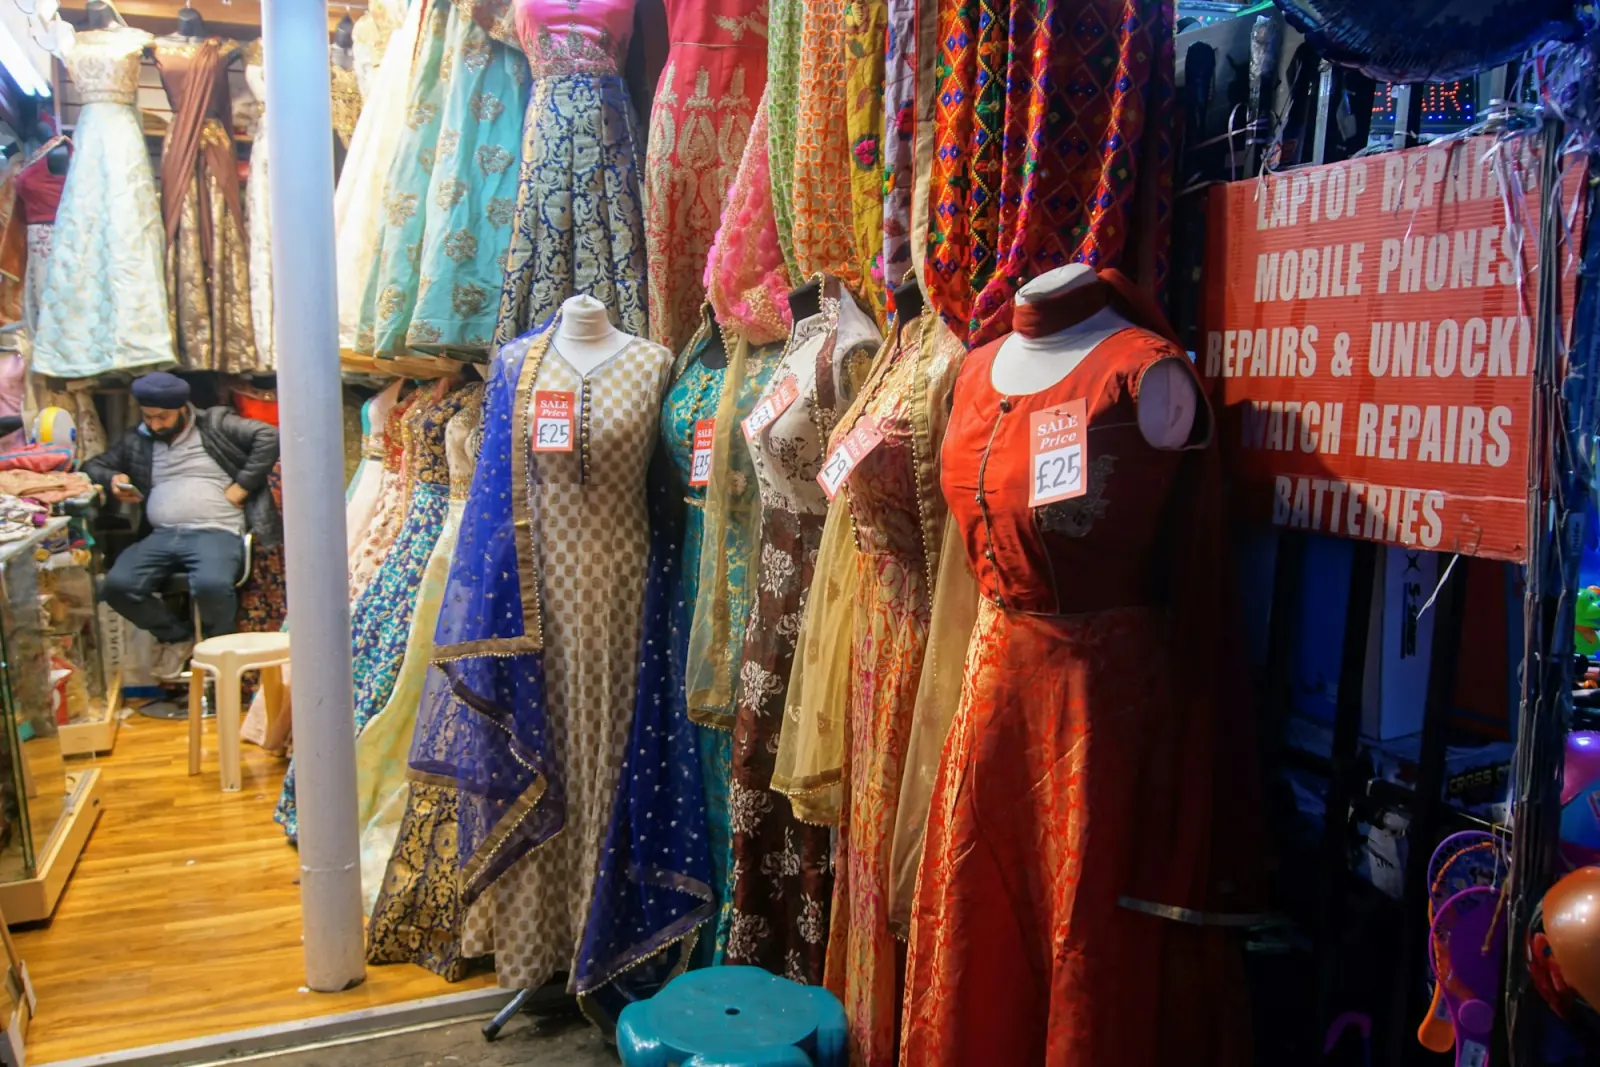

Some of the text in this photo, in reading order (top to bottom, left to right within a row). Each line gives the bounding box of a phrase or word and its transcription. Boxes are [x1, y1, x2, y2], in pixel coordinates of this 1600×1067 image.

[1256, 163, 1367, 230] LAPTOP
[1254, 225, 1525, 303] MOBILE PHONES
[1205, 324, 1318, 378] REPAIRS
[1330, 332, 1353, 377] &
[542, 409, 567, 417] Price
[537, 423, 569, 443] £25
[697, 428, 713, 437] SALE
[1037, 415, 1078, 437] SALE
[1241, 400, 1512, 467] WATCH REPAIRS
[845, 438, 861, 458] Price
[856, 427, 873, 450] SALE
[1040, 432, 1077, 450] Price
[1036, 451, 1080, 494] £25
[1272, 475, 1444, 547] BATTERIES
